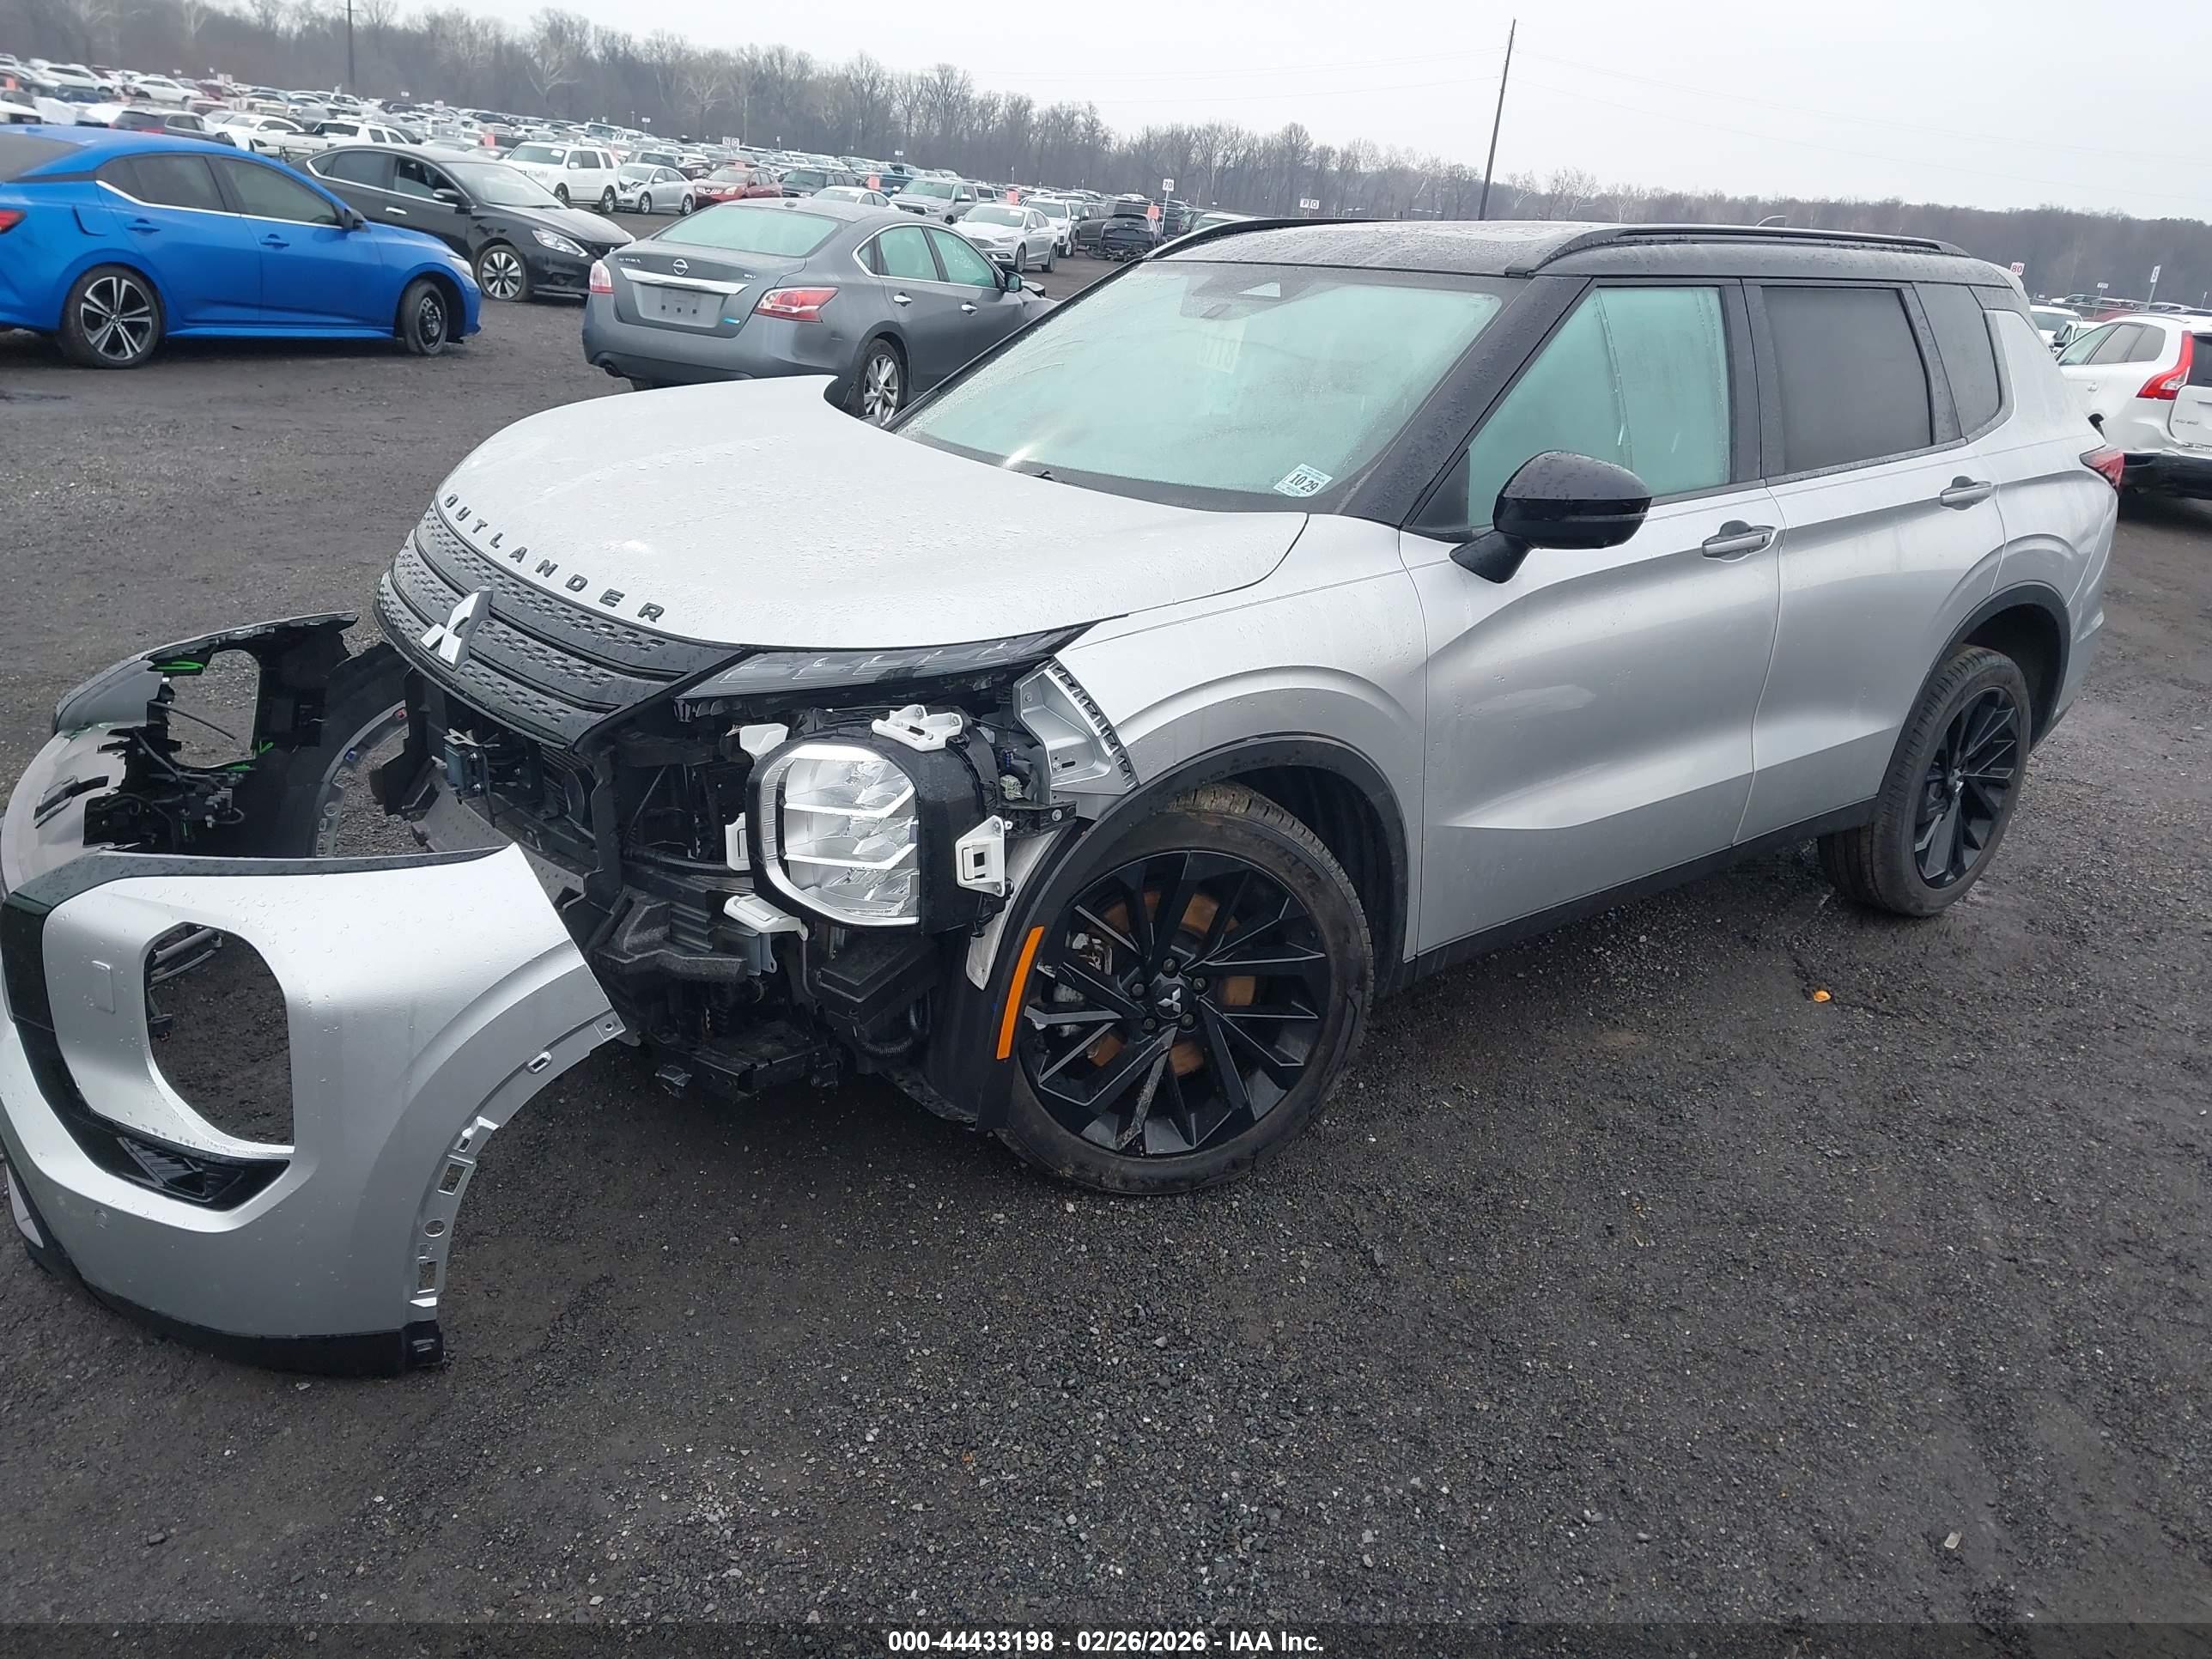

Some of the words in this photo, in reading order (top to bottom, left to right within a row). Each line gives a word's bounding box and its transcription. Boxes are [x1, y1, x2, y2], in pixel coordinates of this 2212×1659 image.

[1289, 473, 1308, 487] 10
[1299, 480, 1320, 493] 29
[444, 493, 665, 623] OUTLANDER
